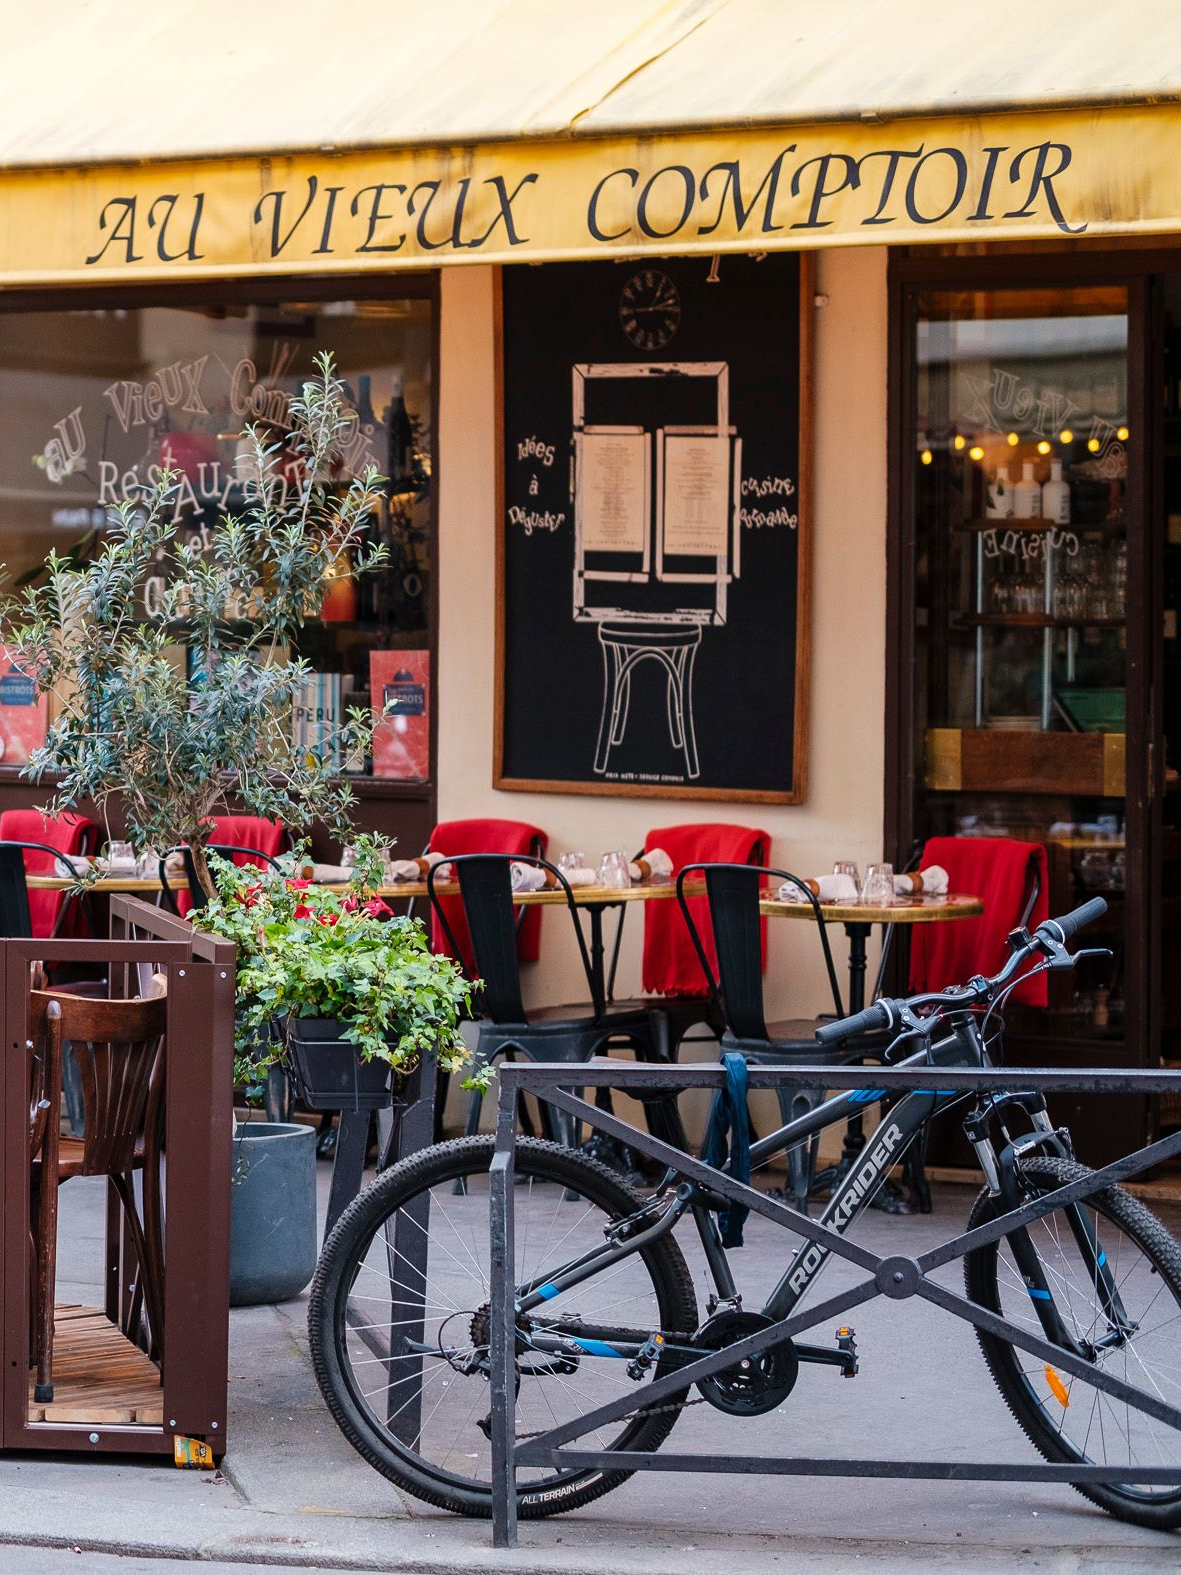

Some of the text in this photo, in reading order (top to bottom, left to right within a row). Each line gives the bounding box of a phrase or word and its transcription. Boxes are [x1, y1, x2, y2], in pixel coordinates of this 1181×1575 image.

[85, 140, 1088, 265] AU VIEUX COMPTOIR
[521, 1483, 576, 1505] ALL TERRAIN
